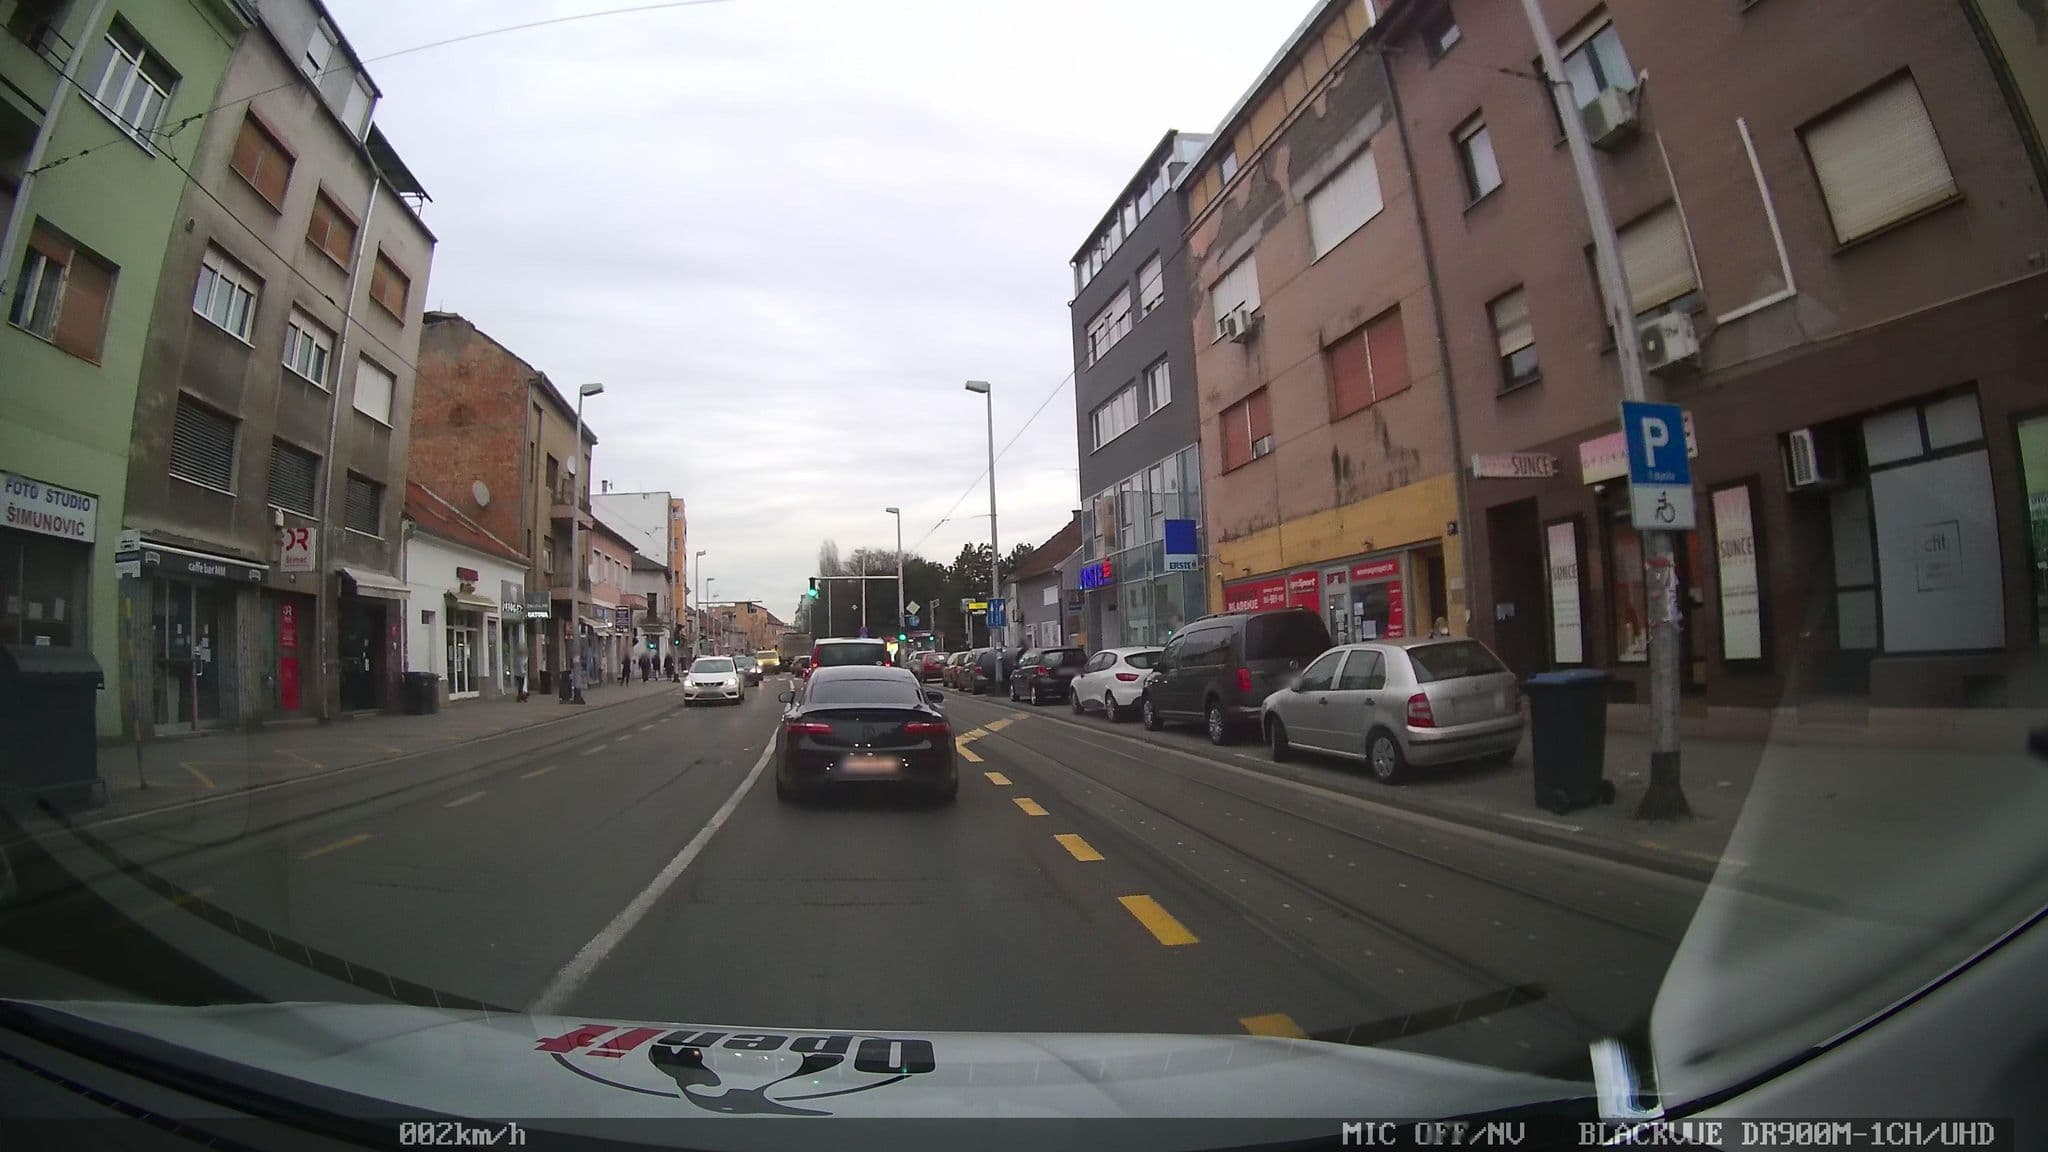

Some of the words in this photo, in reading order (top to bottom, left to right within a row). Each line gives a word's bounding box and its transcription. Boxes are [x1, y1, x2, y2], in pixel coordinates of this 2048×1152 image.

[1641, 416, 1669, 468] P
[1511, 455, 1549, 475] SUNCE
[5, 479, 39, 499] FOTO
[46, 488, 90, 512] STUDIO
[1720, 536, 1754, 558] SUNCE
[1169, 560, 1192, 570] ERSTE
